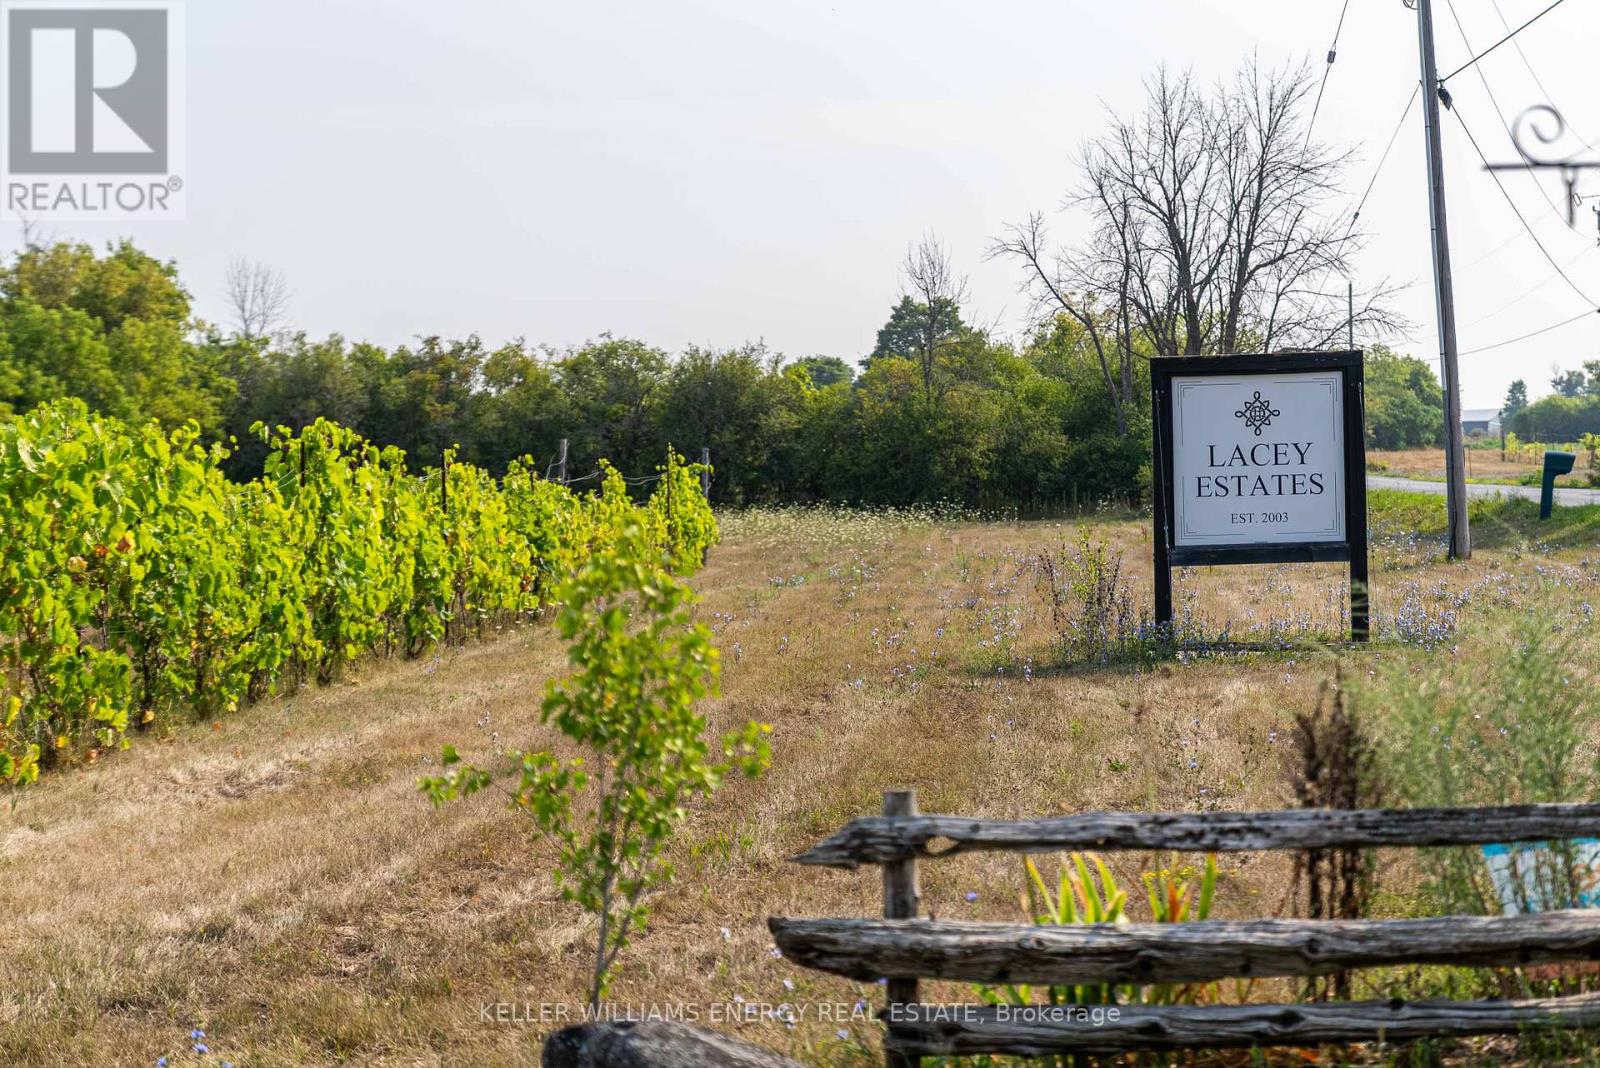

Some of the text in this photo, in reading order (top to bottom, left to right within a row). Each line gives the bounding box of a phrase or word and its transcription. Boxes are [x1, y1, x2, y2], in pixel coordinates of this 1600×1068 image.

[1208, 442, 1313, 467] LACEY
[1195, 473, 1324, 498] ESTATES
[1231, 512, 1289, 524] EST. 2003
